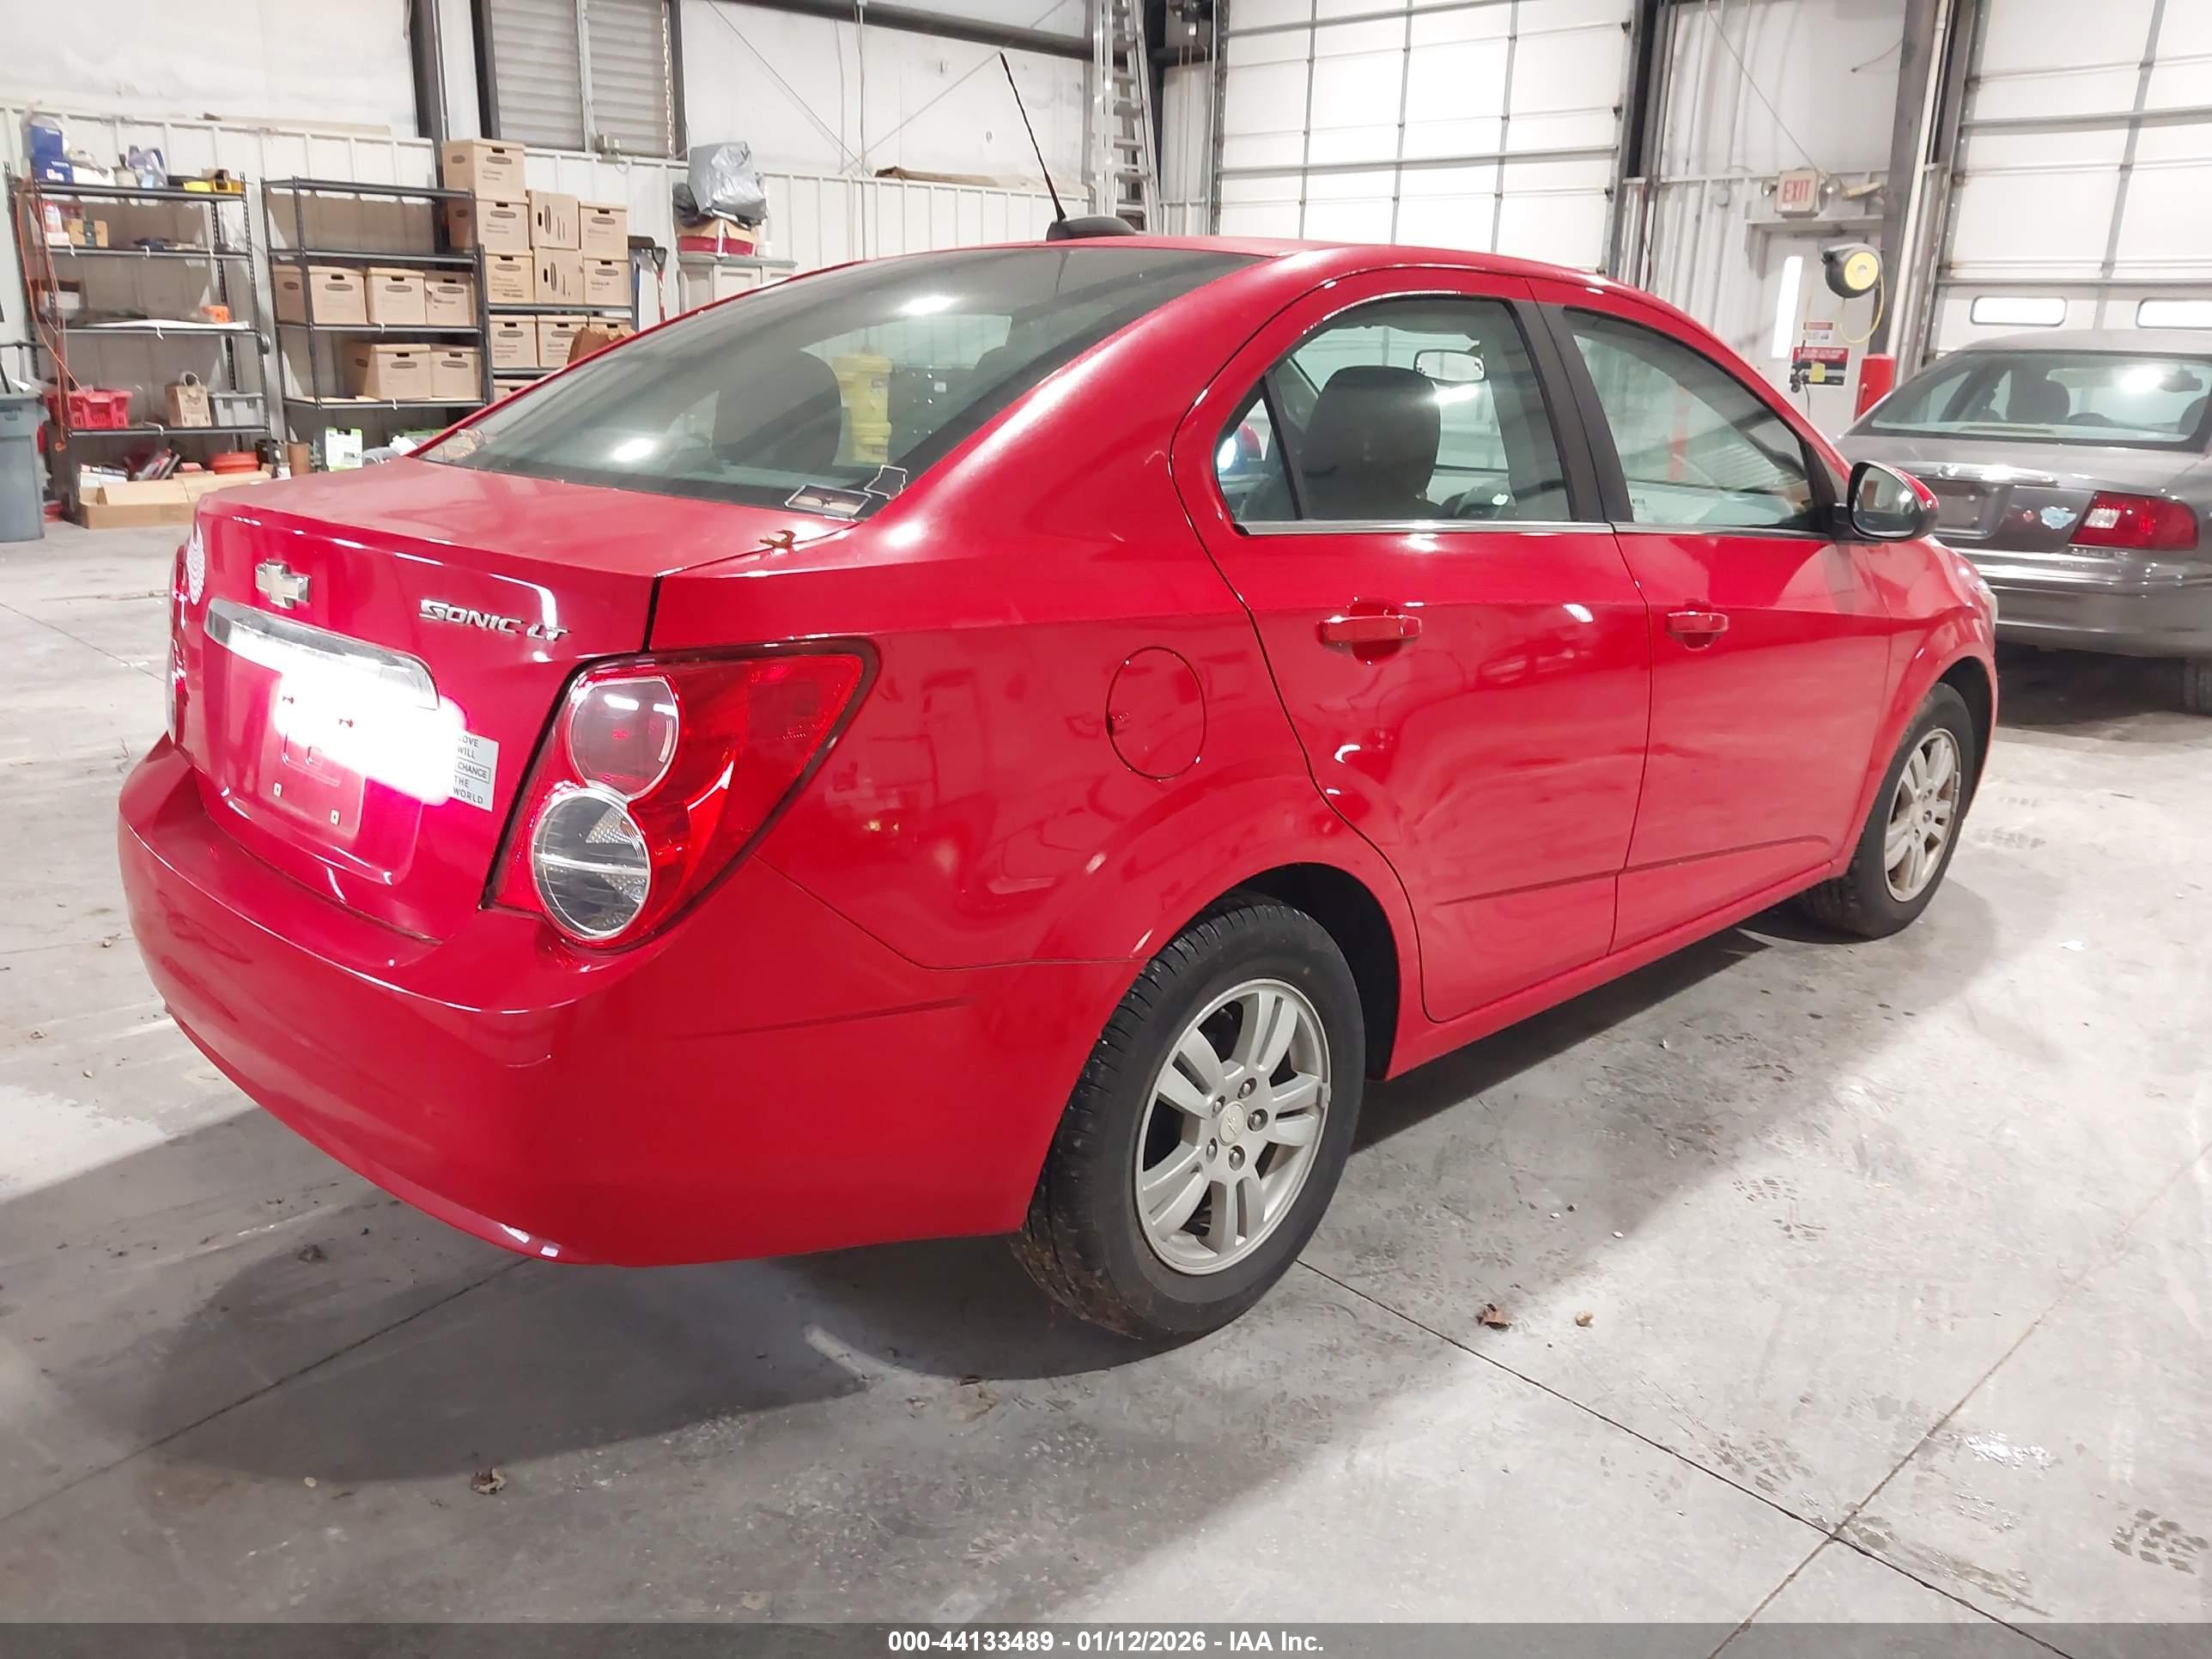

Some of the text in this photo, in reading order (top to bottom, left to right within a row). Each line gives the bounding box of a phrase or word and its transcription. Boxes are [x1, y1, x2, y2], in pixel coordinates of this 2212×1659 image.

[1782, 179, 1811, 203] EXIT
[418, 599, 571, 641] SONIC LT
[458, 734, 479, 748] OVE
[457, 762, 488, 779] CHANGE
[453, 775, 470, 788] THE
[453, 786, 483, 805] WORLD
